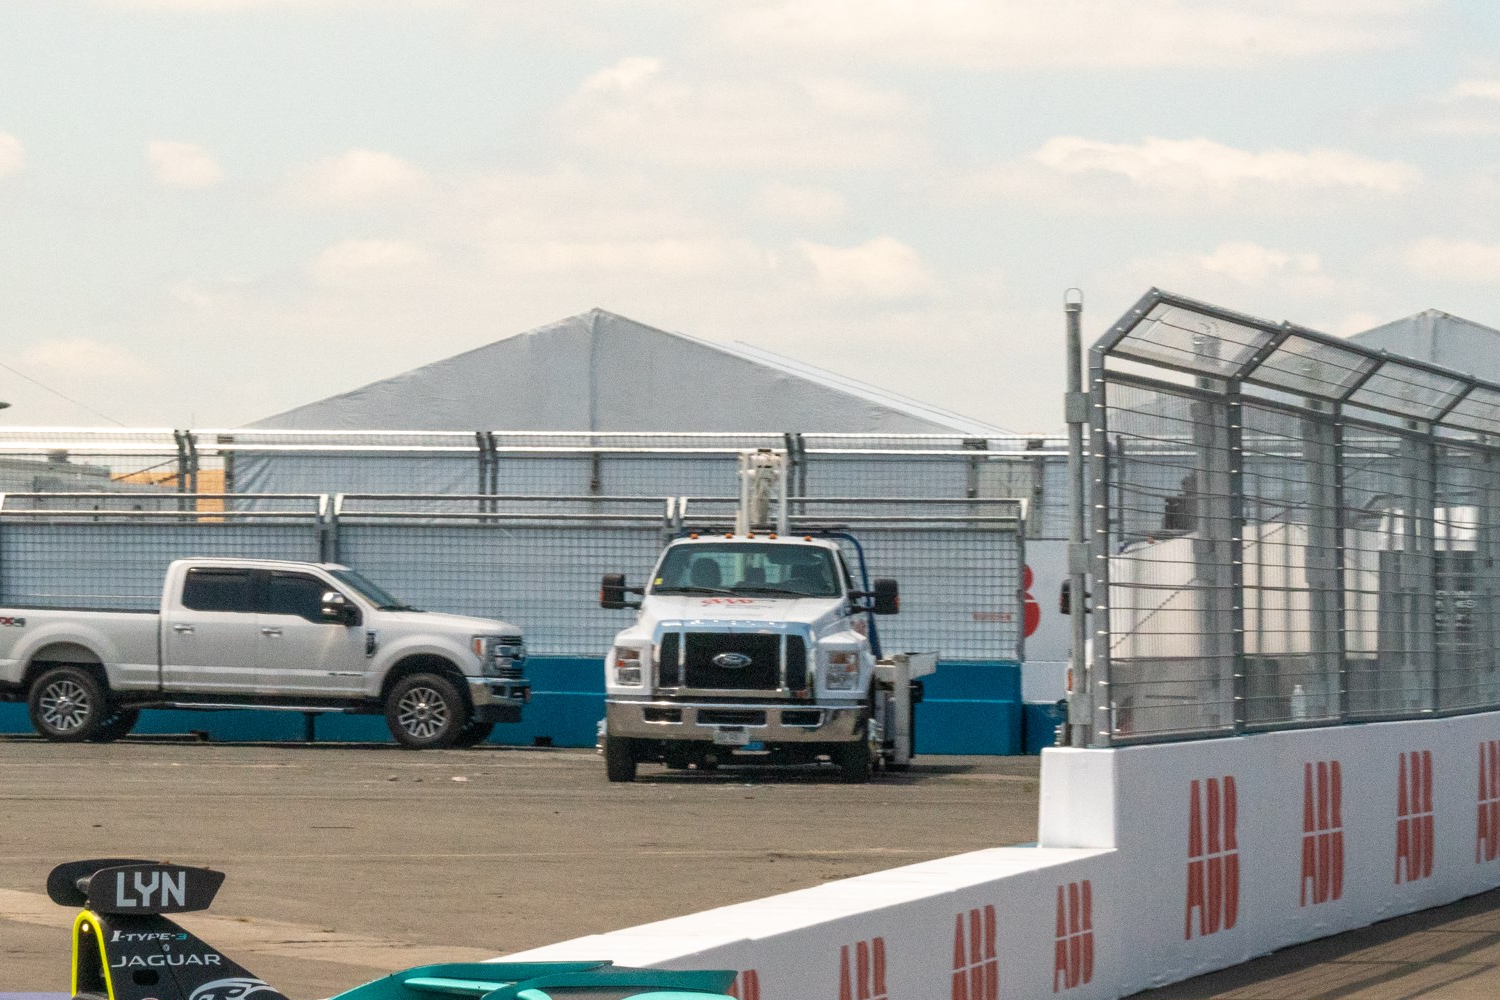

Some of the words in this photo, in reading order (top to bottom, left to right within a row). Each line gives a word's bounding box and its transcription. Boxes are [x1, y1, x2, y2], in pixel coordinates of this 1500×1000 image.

[1184, 775, 1240, 940] ABB
[1300, 760, 1344, 907] ABB
[1394, 750, 1434, 884] ABB
[1475, 740, 1500, 864] AB
[116, 871, 186, 907] LYN
[1053, 879, 1094, 993] ABB
[111, 954, 221, 968] JAGUAR
